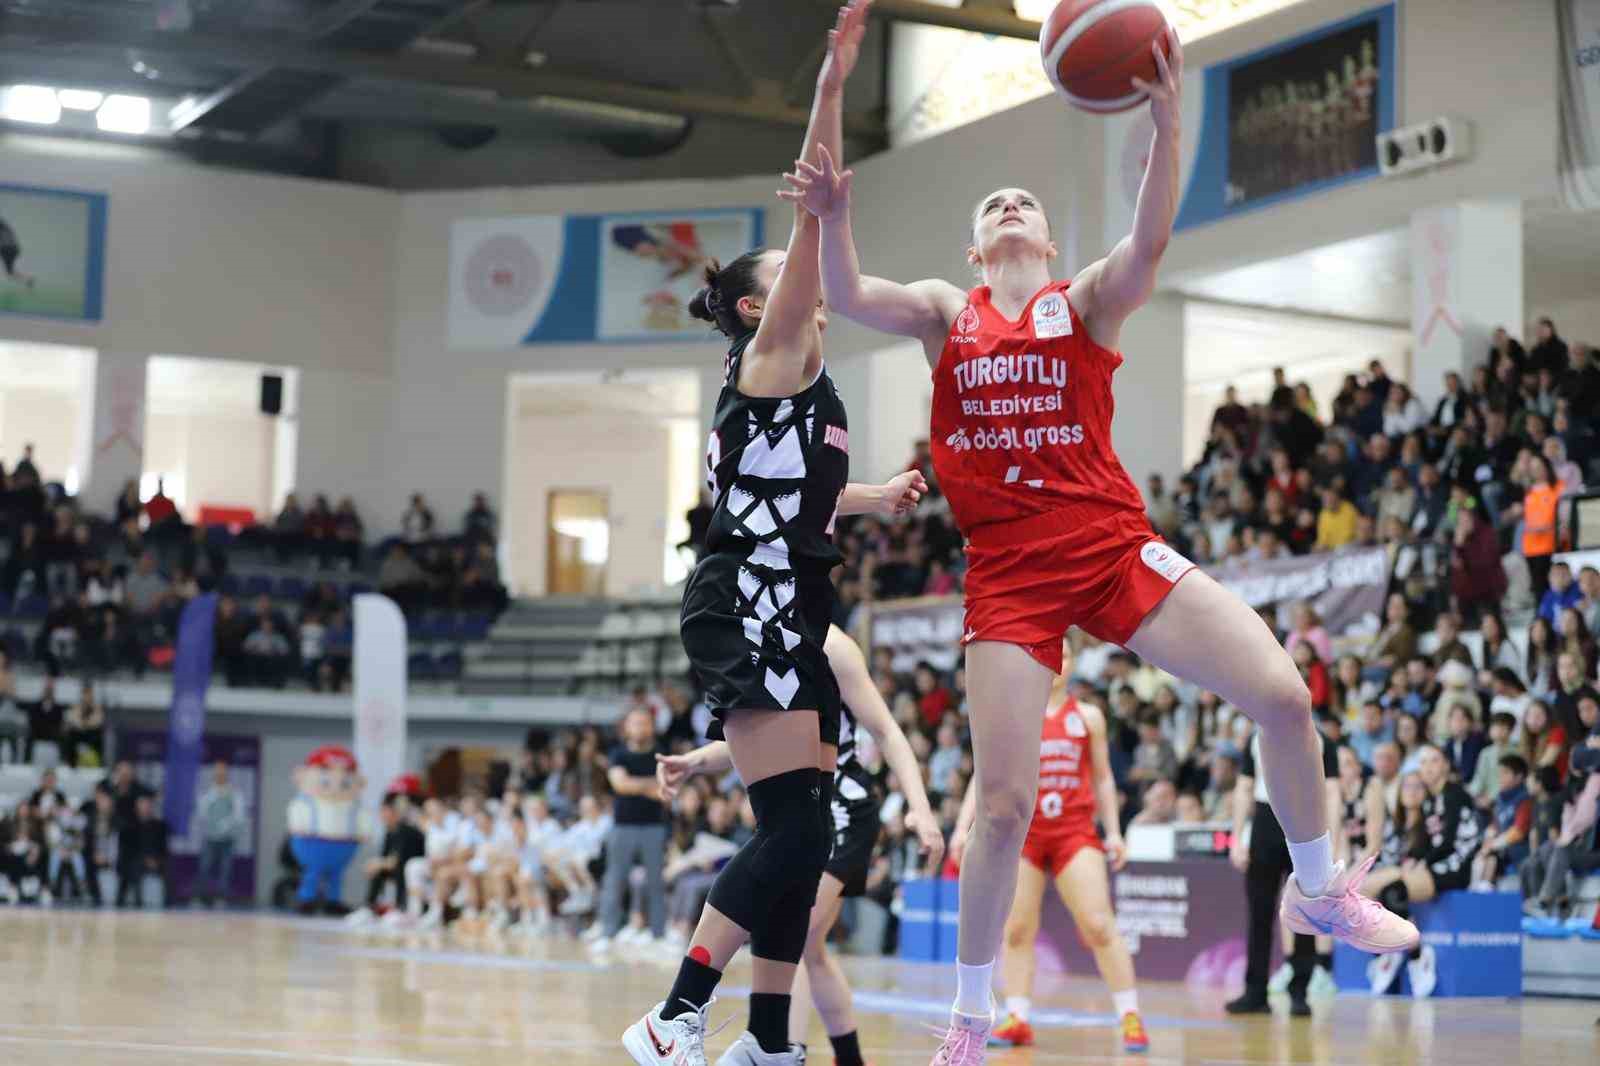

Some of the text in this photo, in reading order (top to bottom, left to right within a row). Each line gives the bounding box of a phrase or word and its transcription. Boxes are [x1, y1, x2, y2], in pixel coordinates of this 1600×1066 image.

[953, 354, 1067, 394] TURGUTLU
[961, 390, 1062, 416] BELEDİYESİ
[1024, 424, 1084, 453] gross
